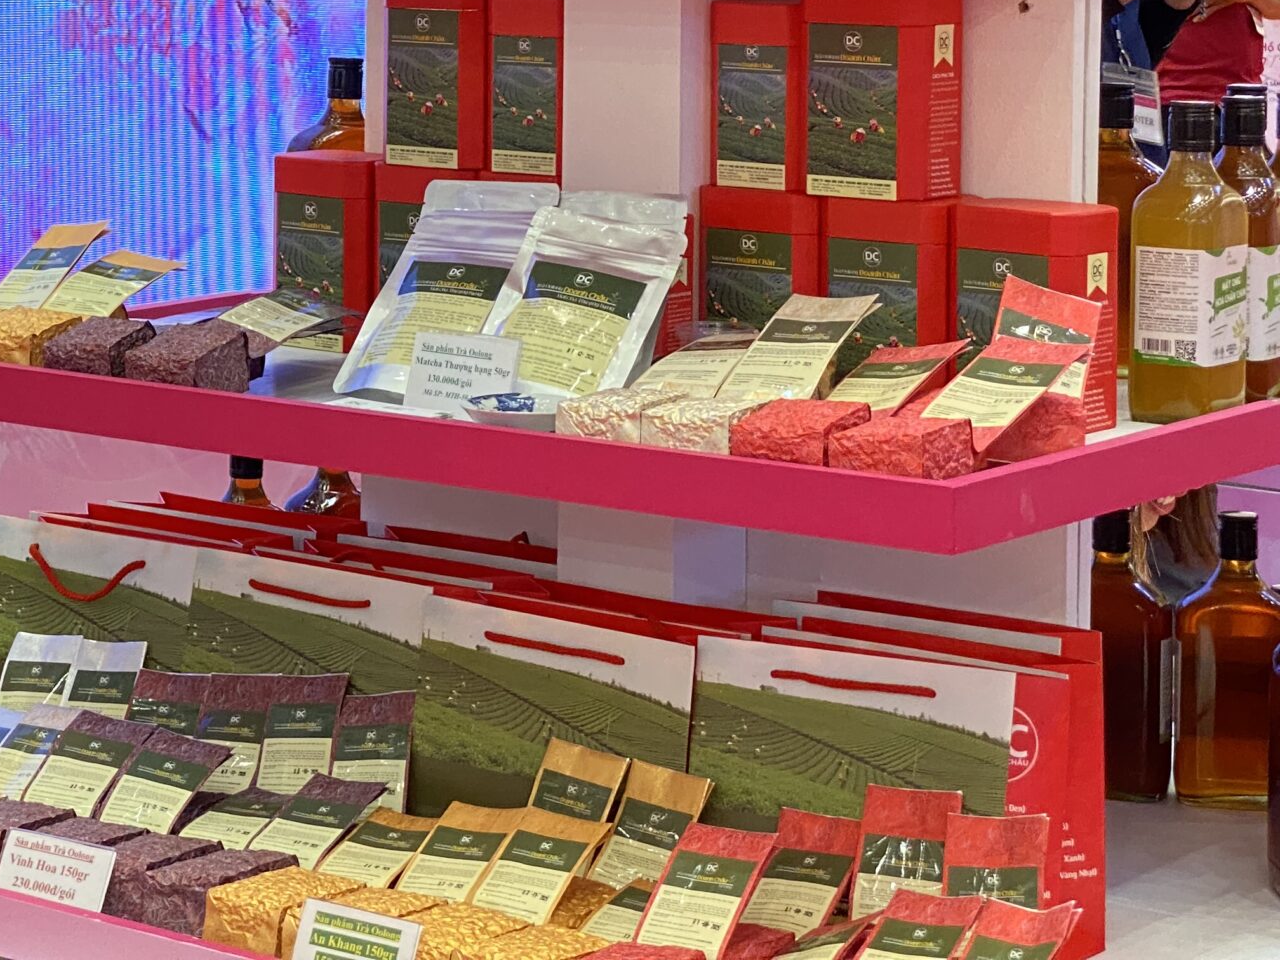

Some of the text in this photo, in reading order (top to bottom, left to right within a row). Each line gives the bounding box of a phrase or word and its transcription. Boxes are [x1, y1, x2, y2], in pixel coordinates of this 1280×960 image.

[846, 35, 860, 45] DC
[421, 342, 492, 360] Sản phẩm Trà Oolong
[415, 356, 510, 377] Matcha Thượng hạng 50gr
[14, 836, 95, 864] Sản phẩm Trà Oolong
[35, 860, 57, 874] Hoa
[60, 865, 90, 882] 150gr
[12, 876, 77, 900] 230.000đ/gói
[315, 913, 400, 942] Sản phẩm Trà Oolong
[311, 932, 395, 960] An Khang 150gr
